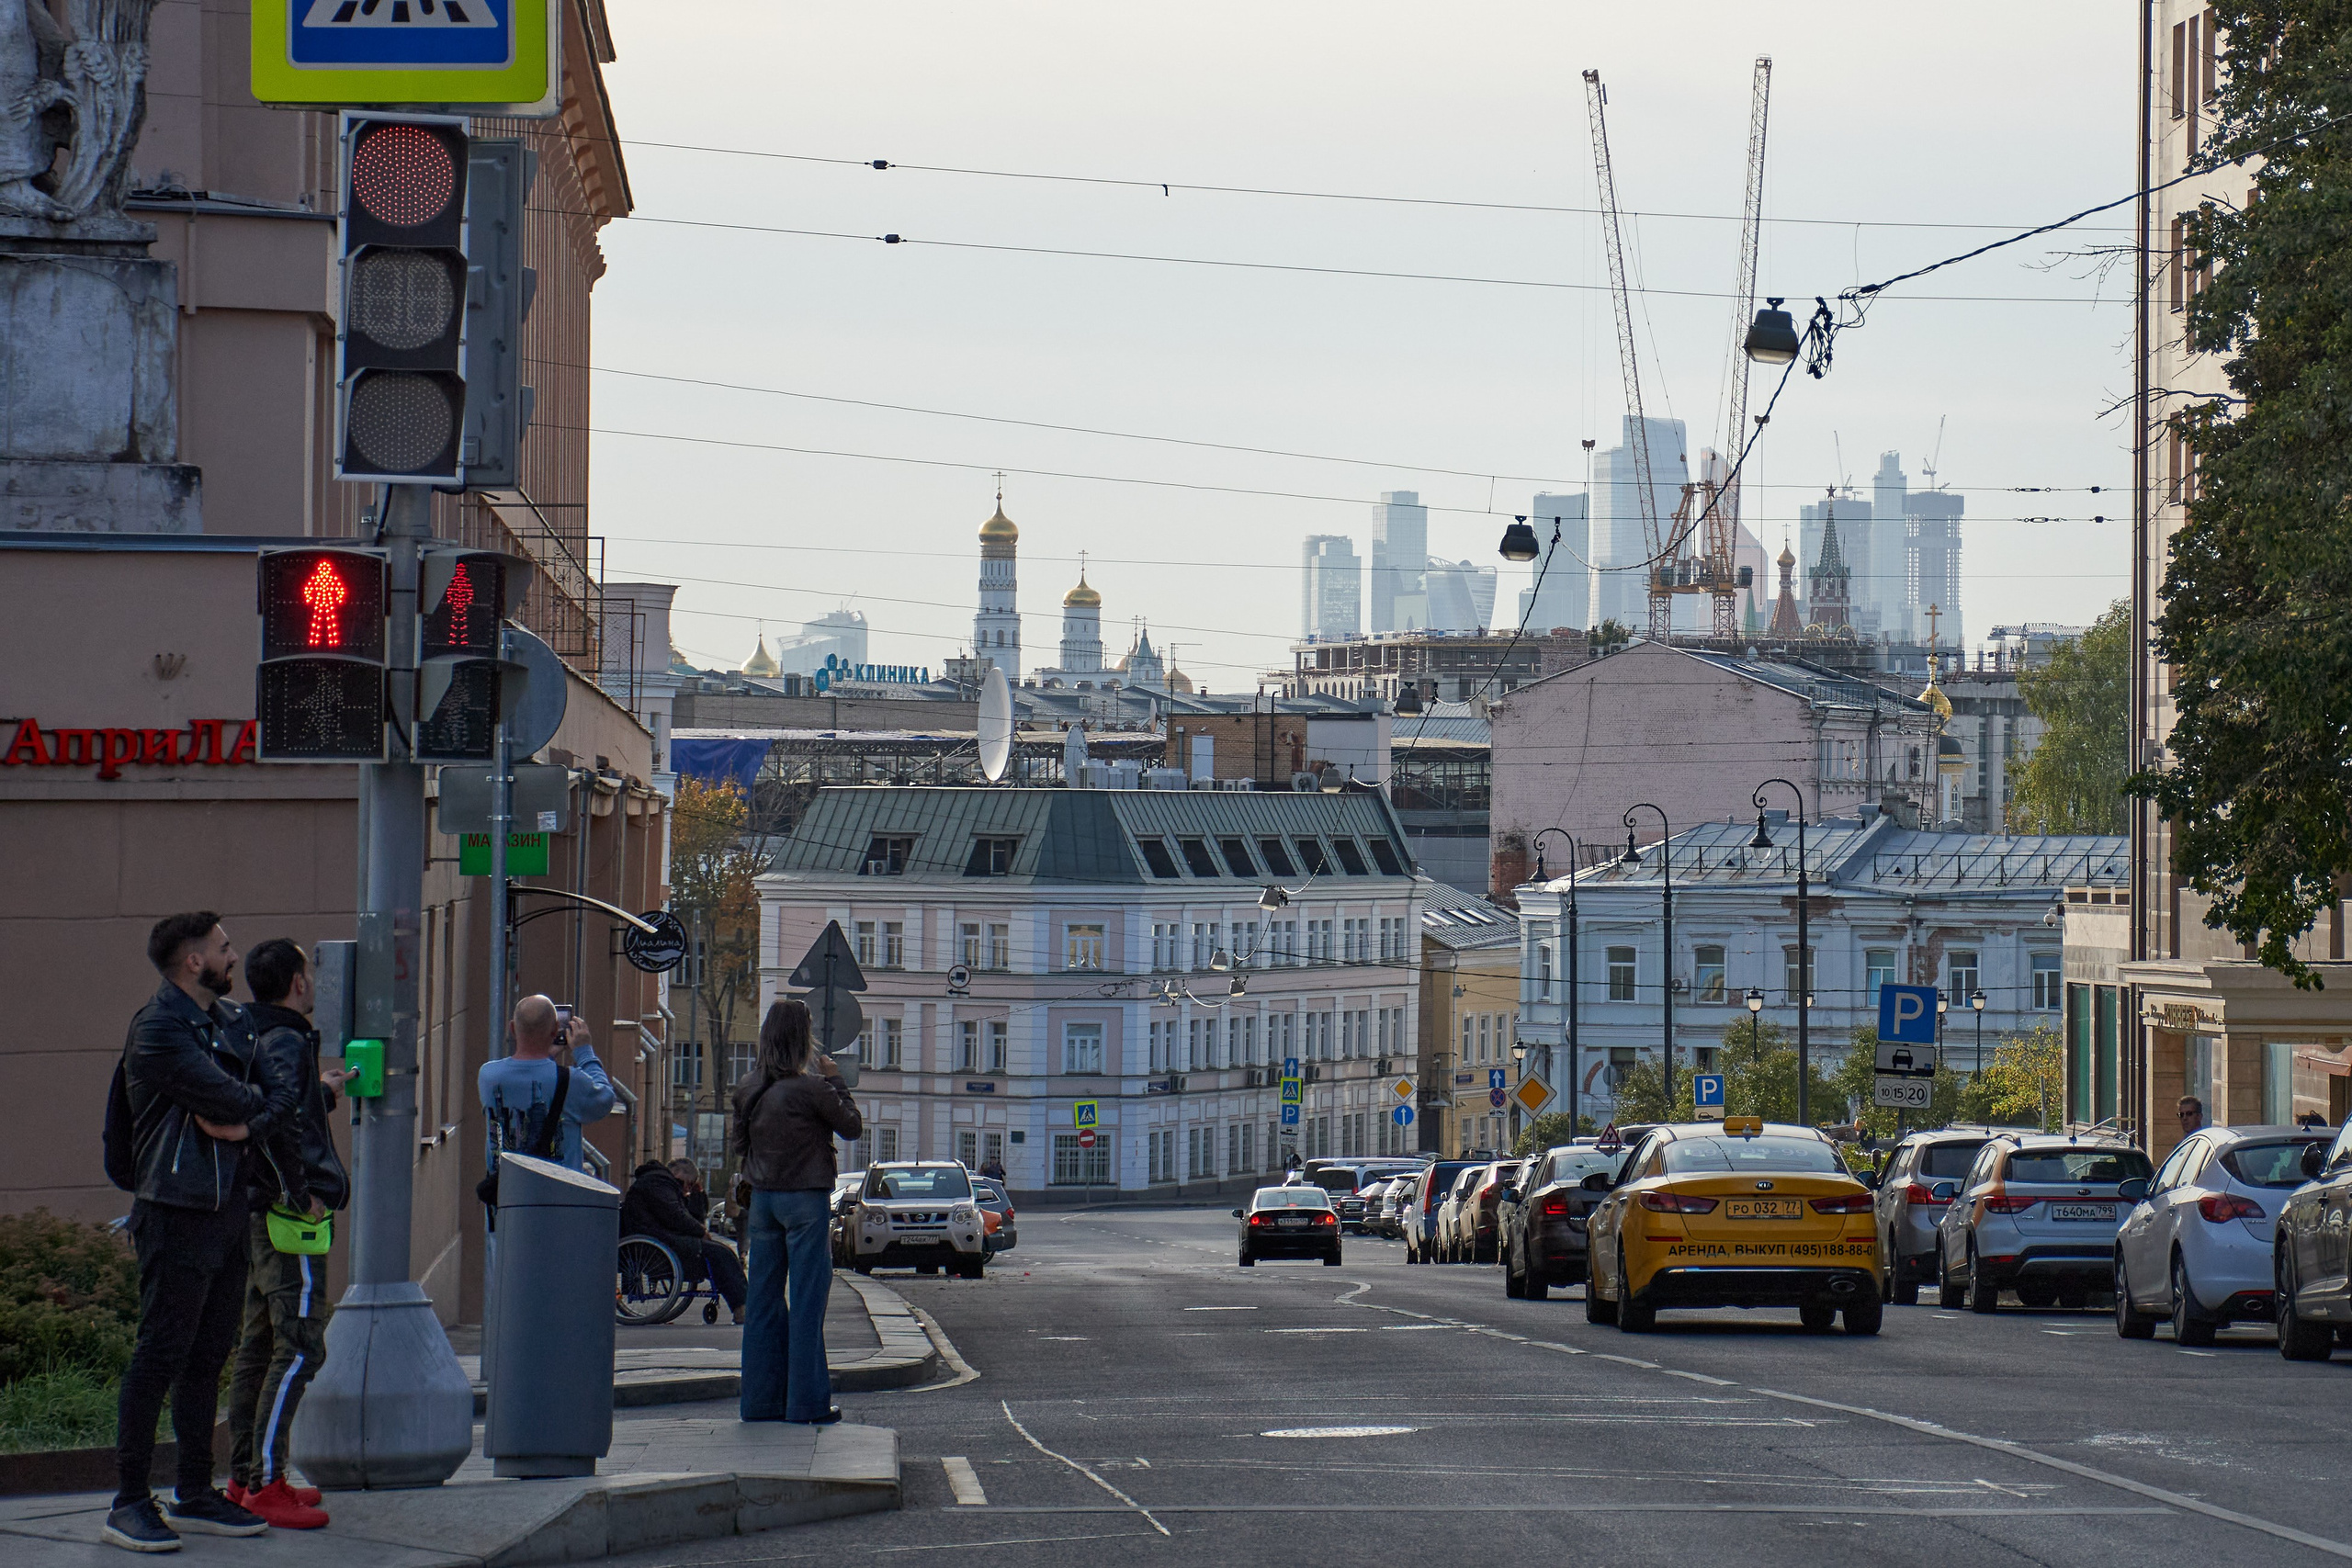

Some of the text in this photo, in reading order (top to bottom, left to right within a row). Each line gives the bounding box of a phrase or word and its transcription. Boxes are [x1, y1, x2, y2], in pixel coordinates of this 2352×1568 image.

[855, 664, 930, 684] КЛИНИКА
[468, 833, 540, 847] МАЗИН
[1894, 993, 1924, 1034] P
[1702, 1078, 1717, 1102] P
[1882, 1088, 1925, 1101] 10 15 20
[1286, 1107, 1295, 1122] P
[1754, 1202, 1777, 1214] 032
[1735, 1245, 1785, 1256] ВЫКУП
